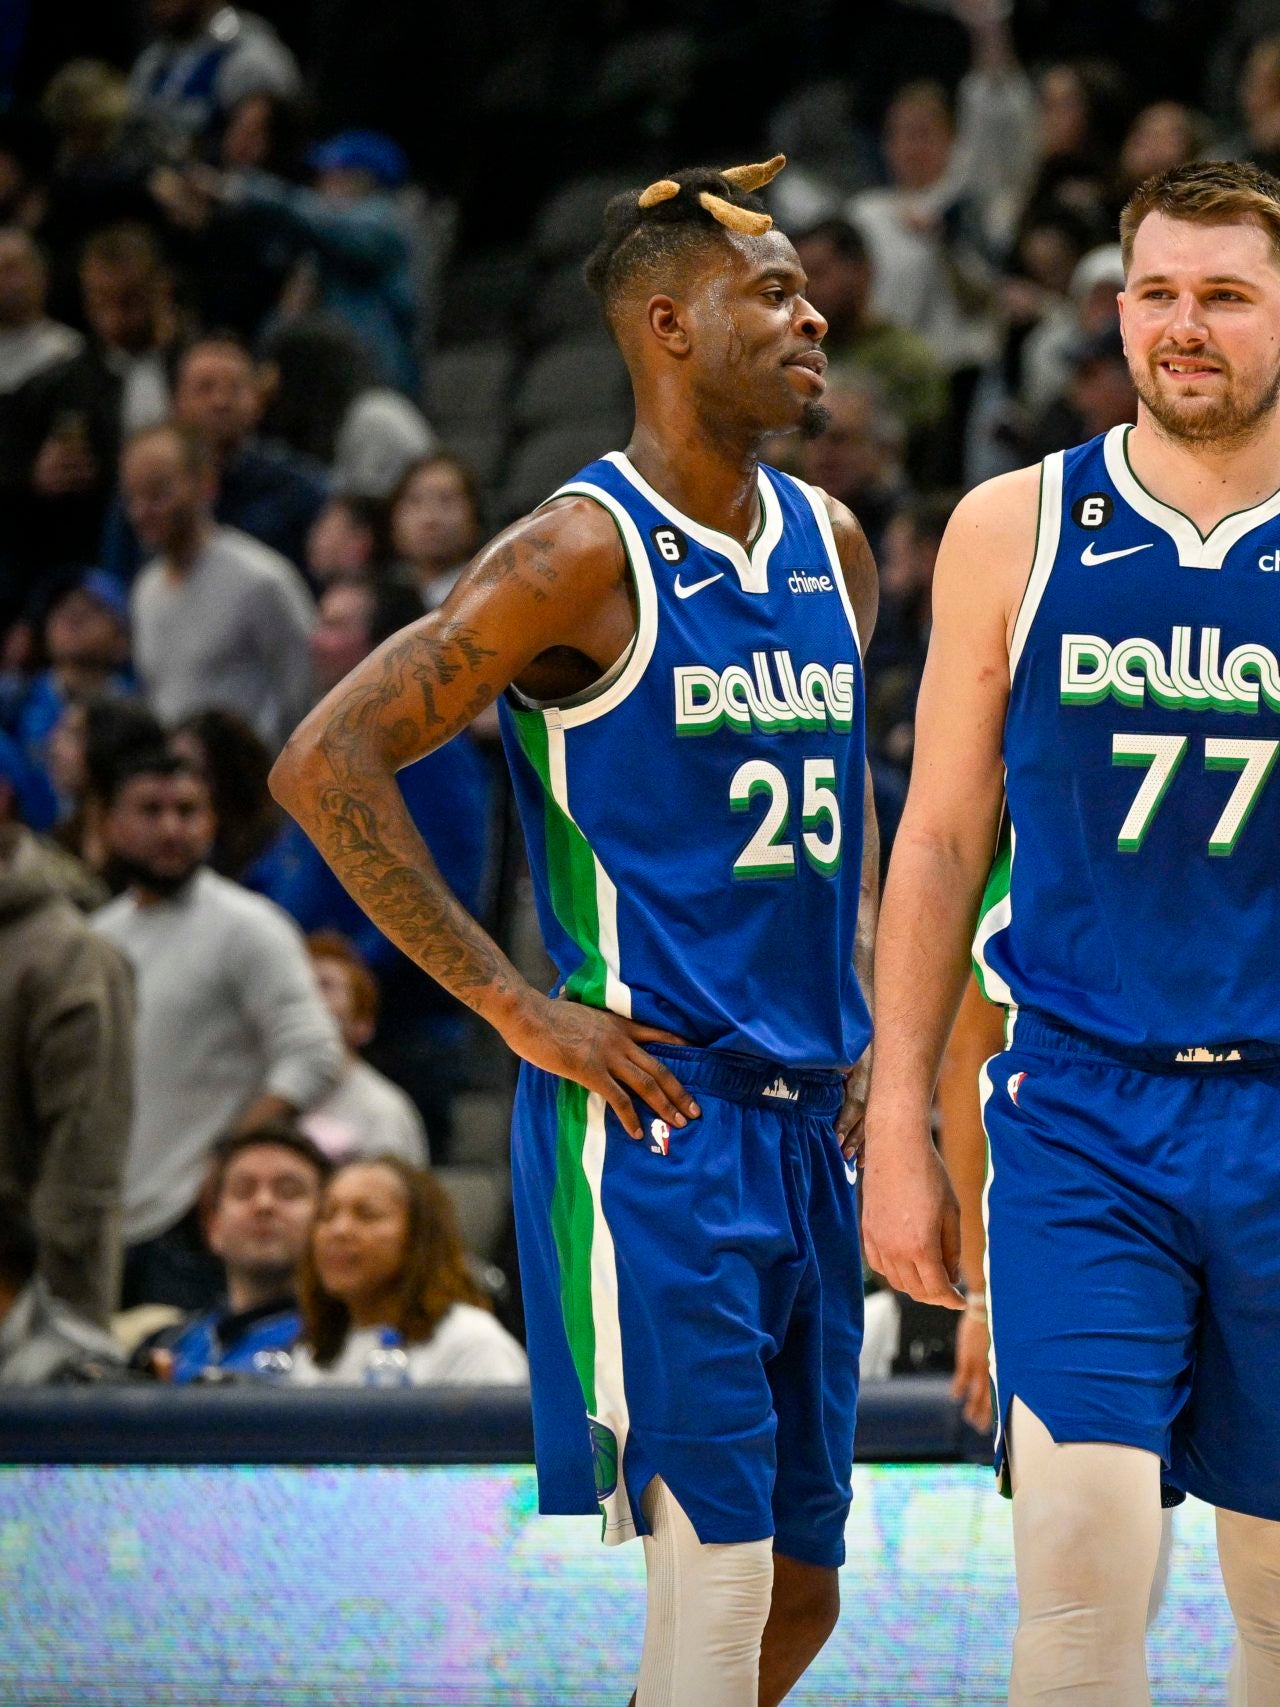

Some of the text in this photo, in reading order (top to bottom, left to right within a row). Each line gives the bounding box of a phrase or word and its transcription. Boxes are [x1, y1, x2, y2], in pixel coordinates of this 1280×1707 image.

[1081, 497, 1105, 526] 6
[656, 531, 681, 561] 6
[788, 570, 834, 593] chime
[674, 650, 854, 737] Dallas
[729, 758, 842, 879] 25
[1112, 733, 1280, 857] 77
